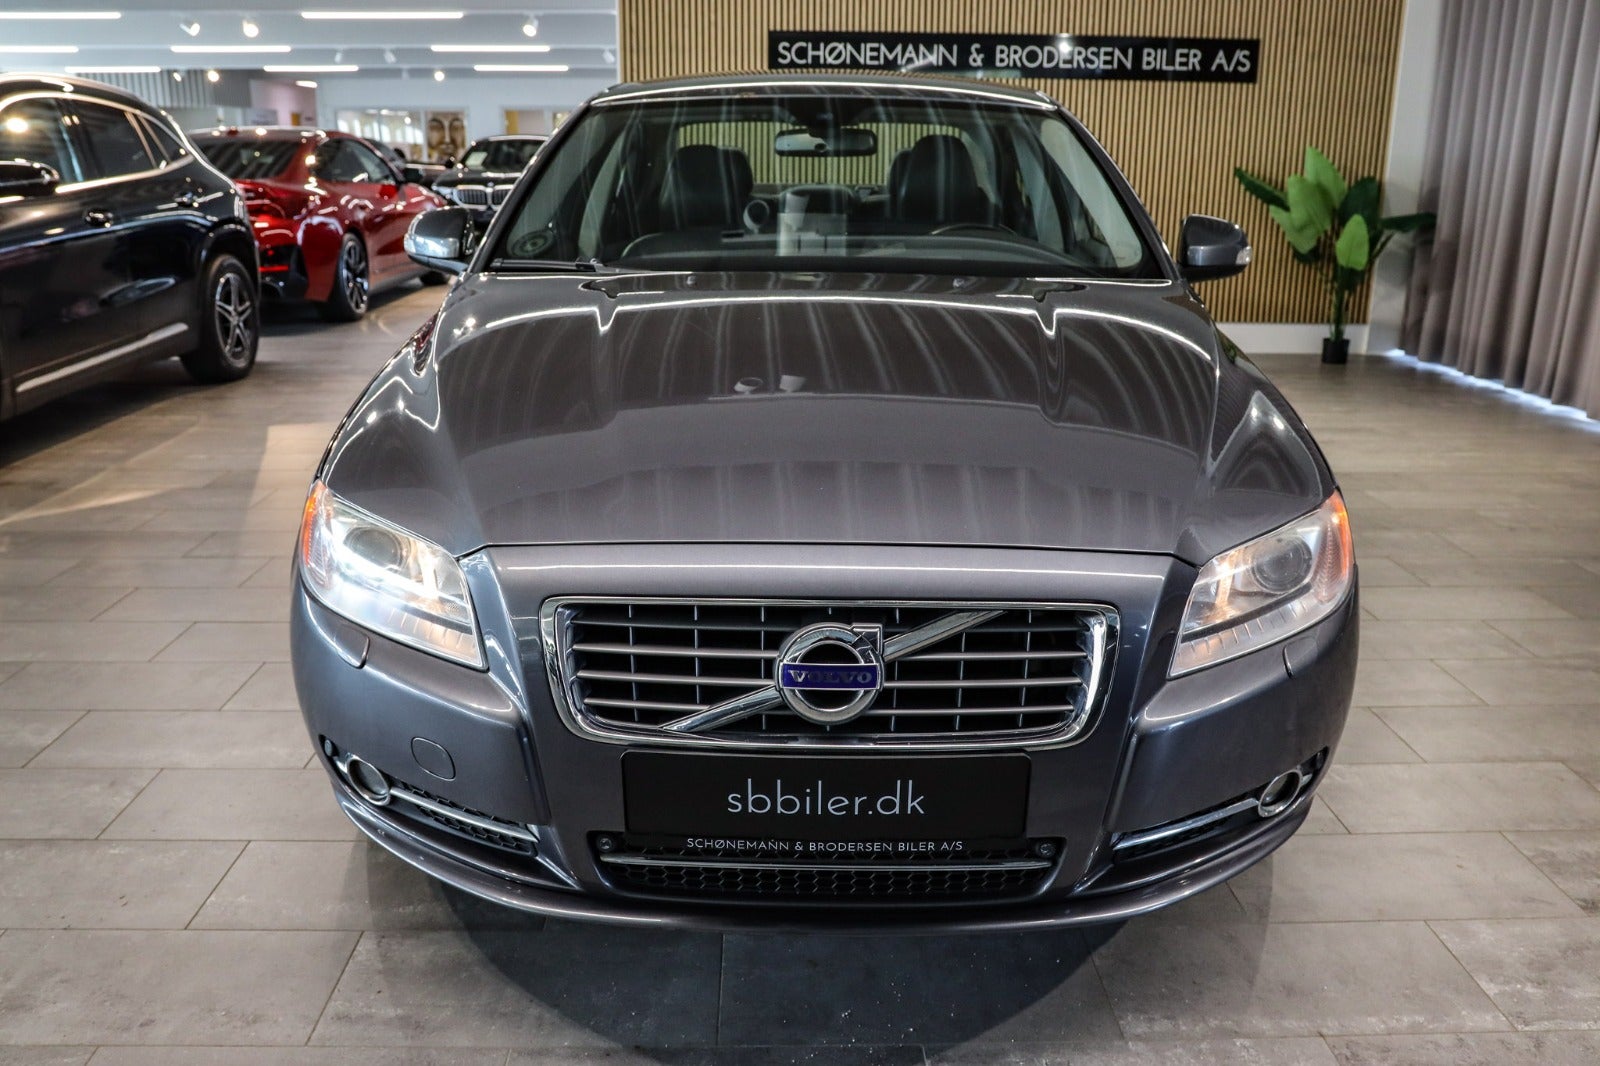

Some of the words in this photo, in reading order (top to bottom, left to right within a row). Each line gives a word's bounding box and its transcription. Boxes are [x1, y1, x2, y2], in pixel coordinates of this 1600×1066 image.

[777, 41, 957, 67] SCHØNEMANN
[968, 43, 984, 67] &
[995, 45, 1132, 70] BRODERSEN
[1142, 48, 1202, 71] BILER
[1210, 49, 1251, 73] A/S
[788, 669, 872, 684] VOLVO
[727, 778, 925, 815] sbbiler.dk
[687, 838, 789, 851] SCHØNEMANN
[794, 841, 804, 851] &
[809, 841, 893, 852] BRODERSEN
[898, 841, 935, 852] BILER
[940, 840, 963, 851] A/S
